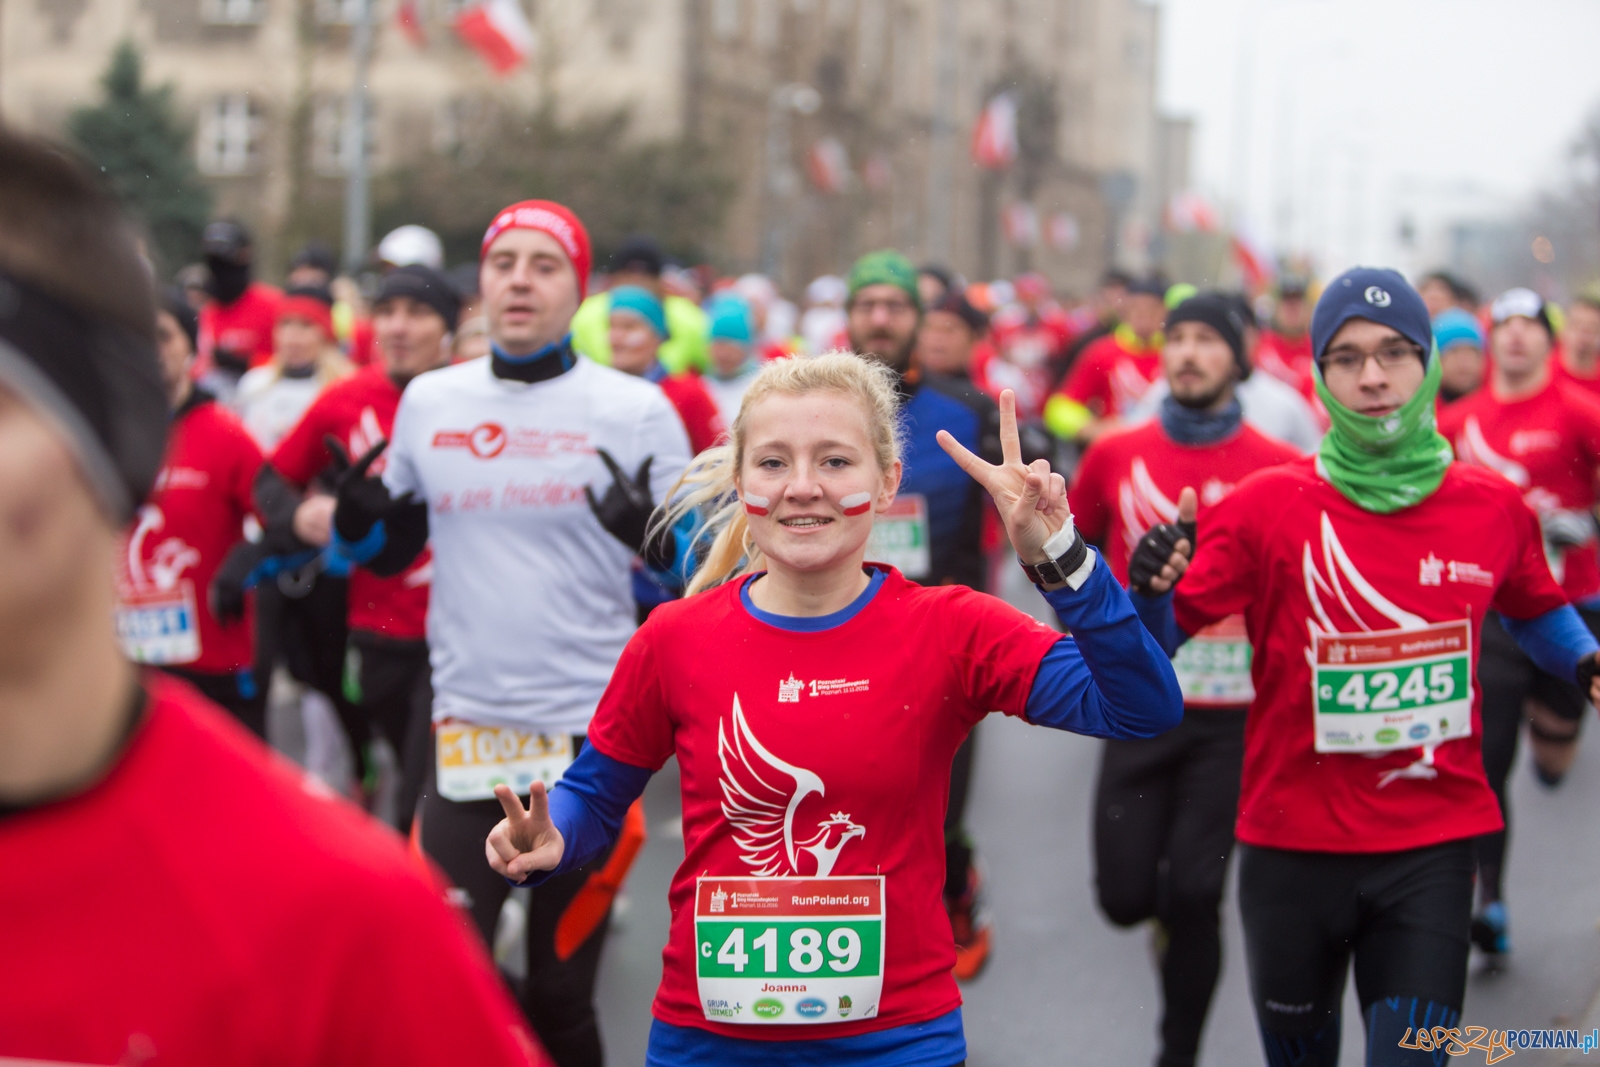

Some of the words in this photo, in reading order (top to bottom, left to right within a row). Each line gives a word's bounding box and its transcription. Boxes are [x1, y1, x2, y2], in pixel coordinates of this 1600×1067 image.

[1401, 637, 1460, 653] RunPoland.org
[808, 679, 819, 696] 1
[1319, 684, 1333, 700] C
[1336, 662, 1455, 711] 4245
[730, 892, 738, 908] 1
[791, 895, 870, 907] RunPoland.org
[701, 941, 713, 958] C
[717, 927, 862, 974] 4189
[761, 983, 807, 993] Joanna
[707, 999, 729, 1008] GRUPA
[757, 1005, 782, 1015] energy
[708, 1007, 734, 1018] LUXMED
